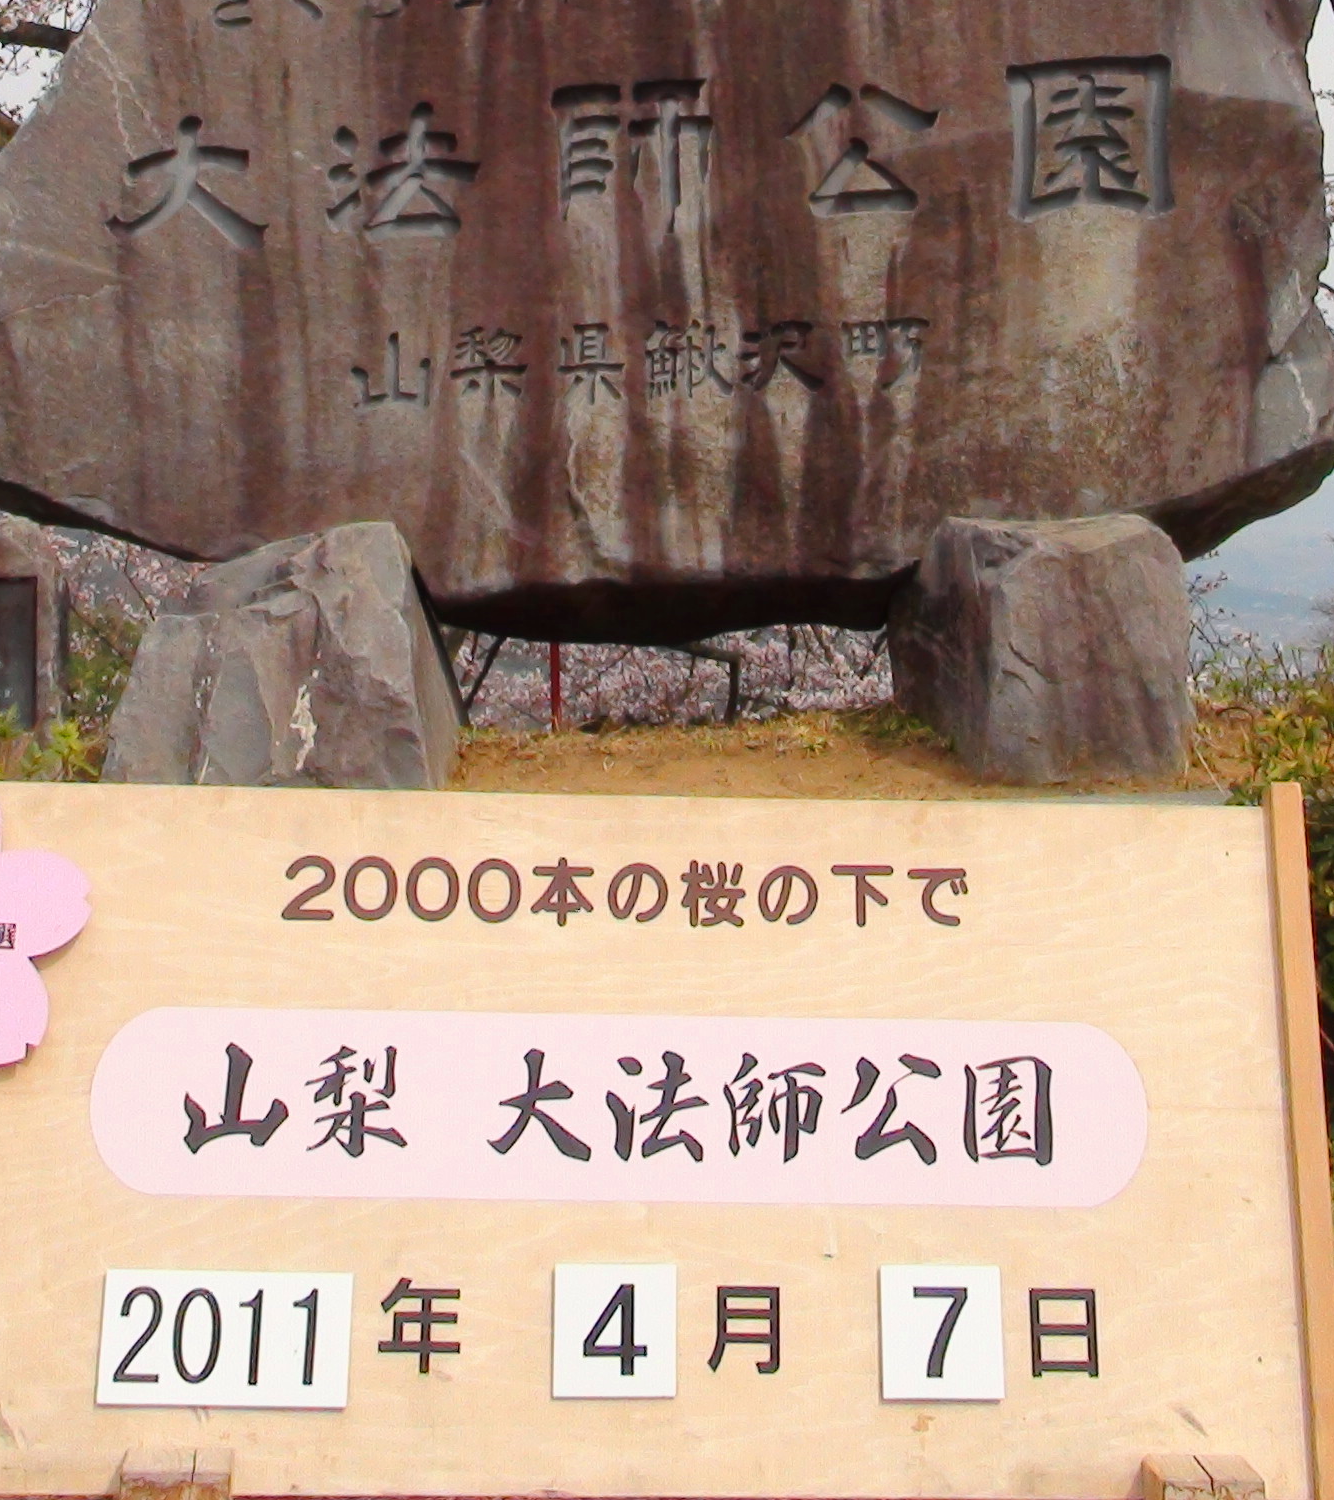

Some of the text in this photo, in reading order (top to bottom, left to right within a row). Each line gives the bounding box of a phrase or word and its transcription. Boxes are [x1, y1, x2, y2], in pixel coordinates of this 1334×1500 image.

[104, 54, 1173, 248] 大法師公園
[351, 317, 929, 410] 山梨県鰍沢町
[283, 855, 971, 929] 2000本の桜の下で
[179, 1042, 1055, 1168] 山梨 大法師公園
